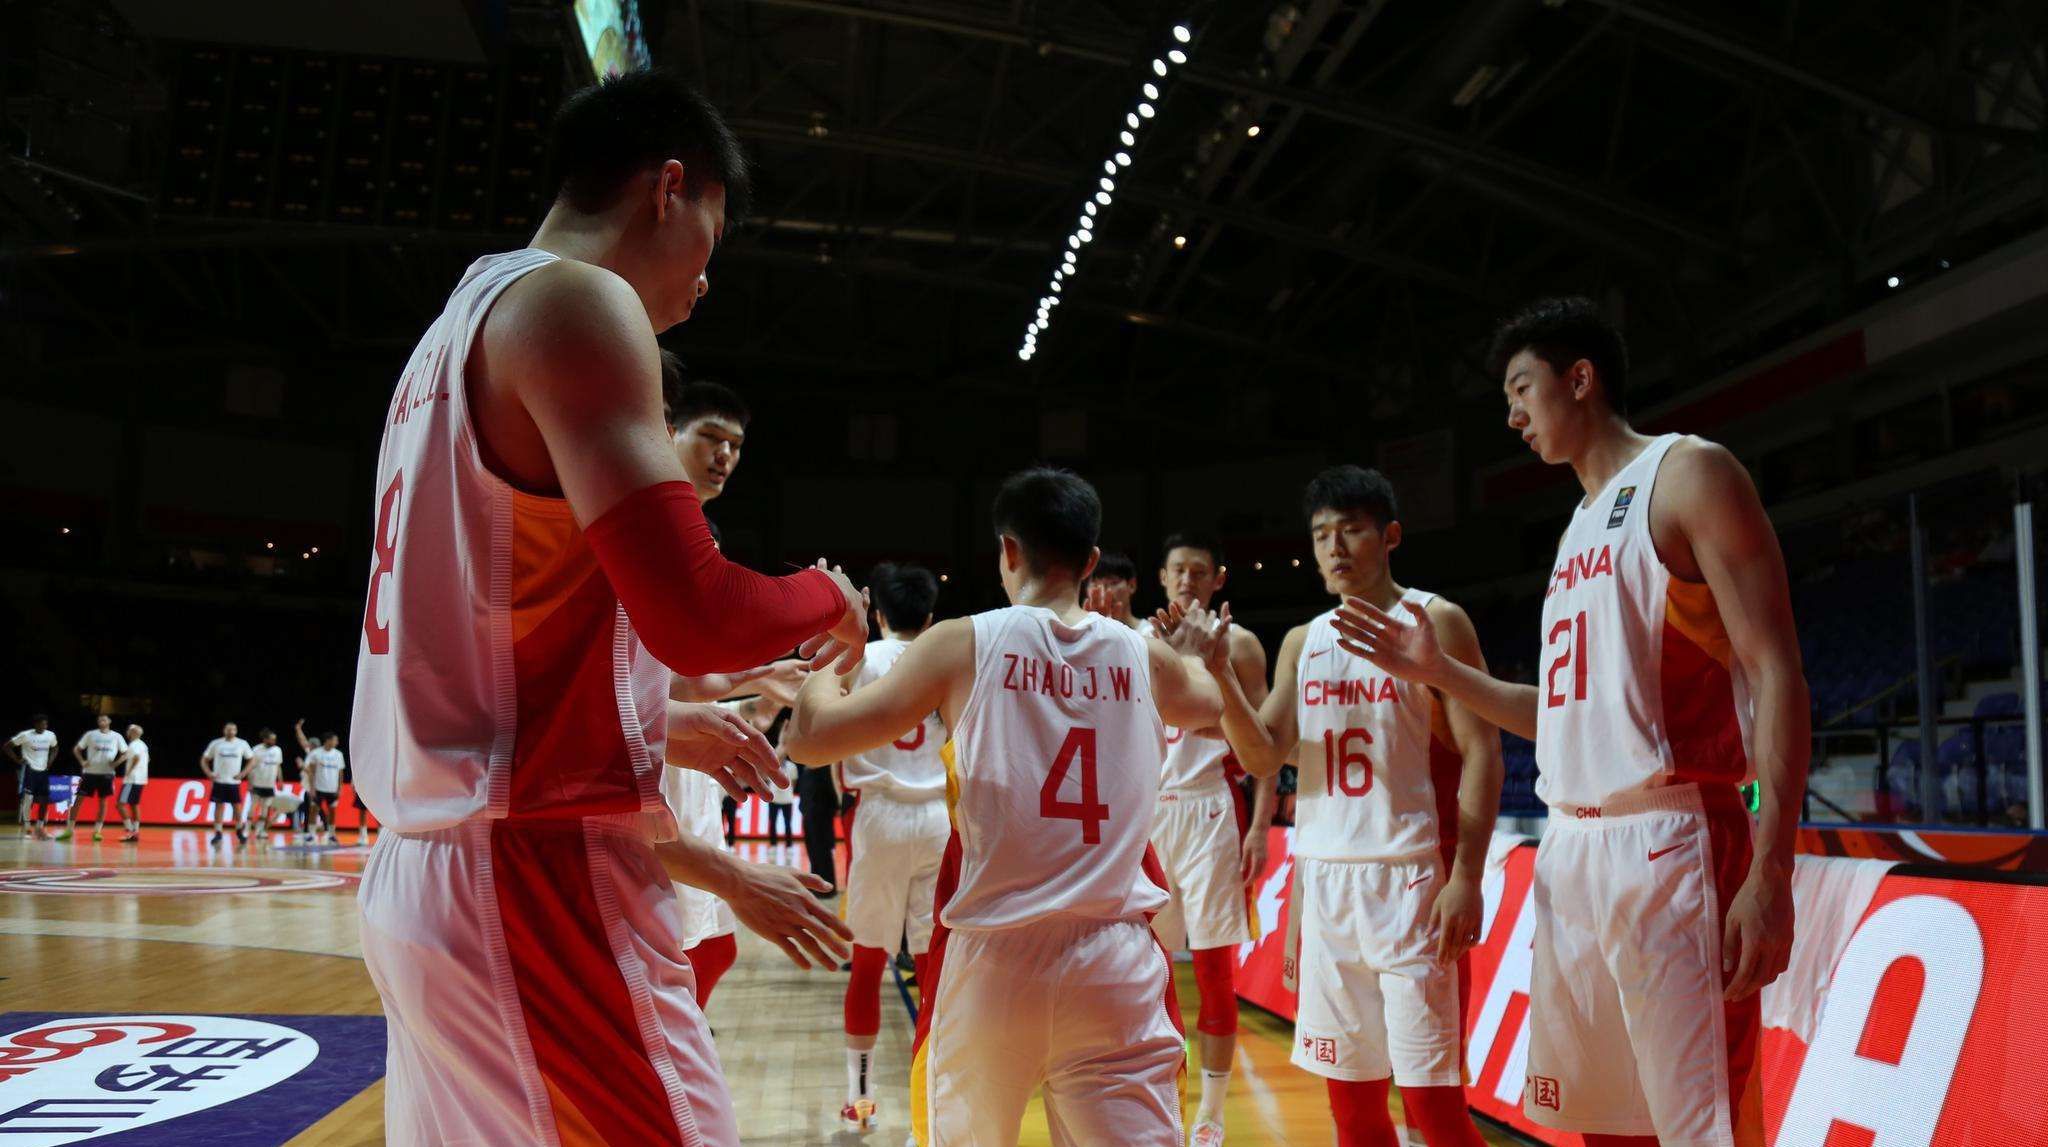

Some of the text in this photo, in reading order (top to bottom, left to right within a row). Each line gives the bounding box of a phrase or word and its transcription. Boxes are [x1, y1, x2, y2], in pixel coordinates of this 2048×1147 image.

[1003, 654, 1141, 702] ZHAO J.W.
[1548, 610, 1588, 708] 21
[1304, 677, 1400, 706] CHINA
[1040, 726, 1109, 844] 4
[1324, 728, 1373, 797] 16
[1576, 807, 1602, 819] CHN
